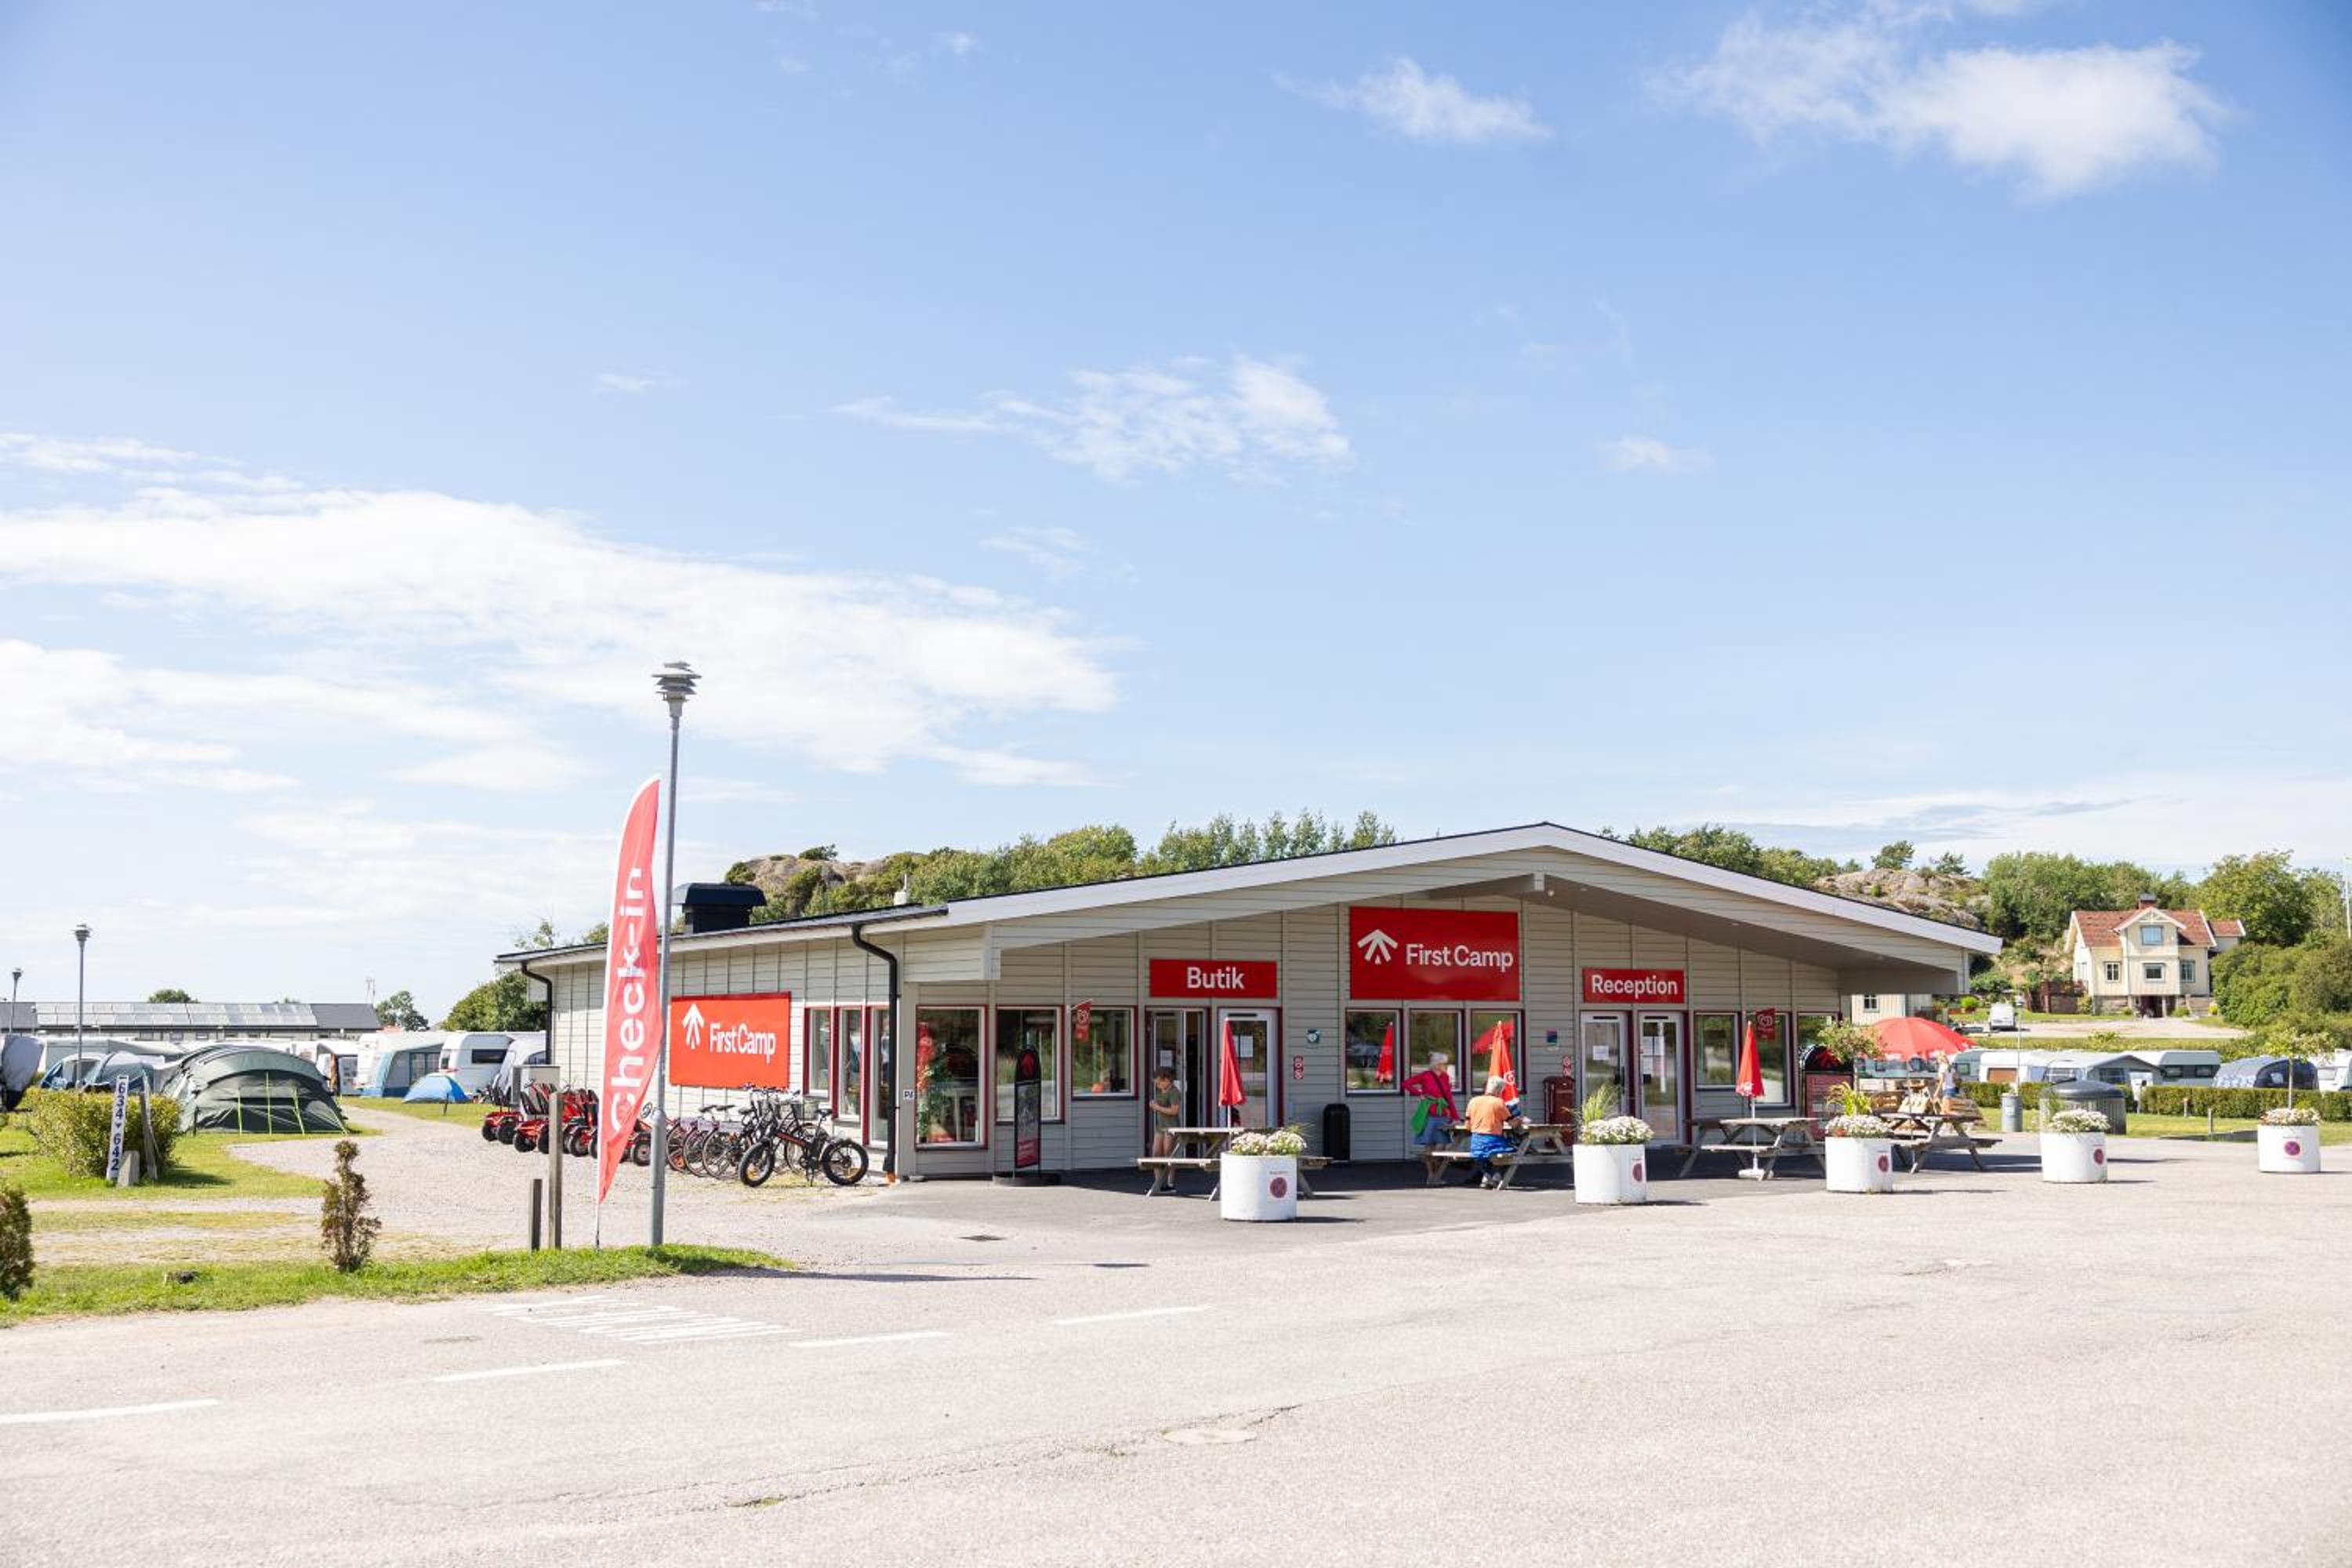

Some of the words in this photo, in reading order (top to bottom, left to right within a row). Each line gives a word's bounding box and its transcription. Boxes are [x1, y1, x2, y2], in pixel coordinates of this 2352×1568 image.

[1406, 943, 1450, 966] First
[1454, 945, 1514, 973] Camp
[1187, 966, 1245, 989] Butik
[1592, 975, 1678, 1000] Reception
[710, 1022, 737, 1054] First
[738, 1023, 776, 1065] Camp
[116, 1082, 126, 1120] 634
[111, 1133, 122, 1171] 642
